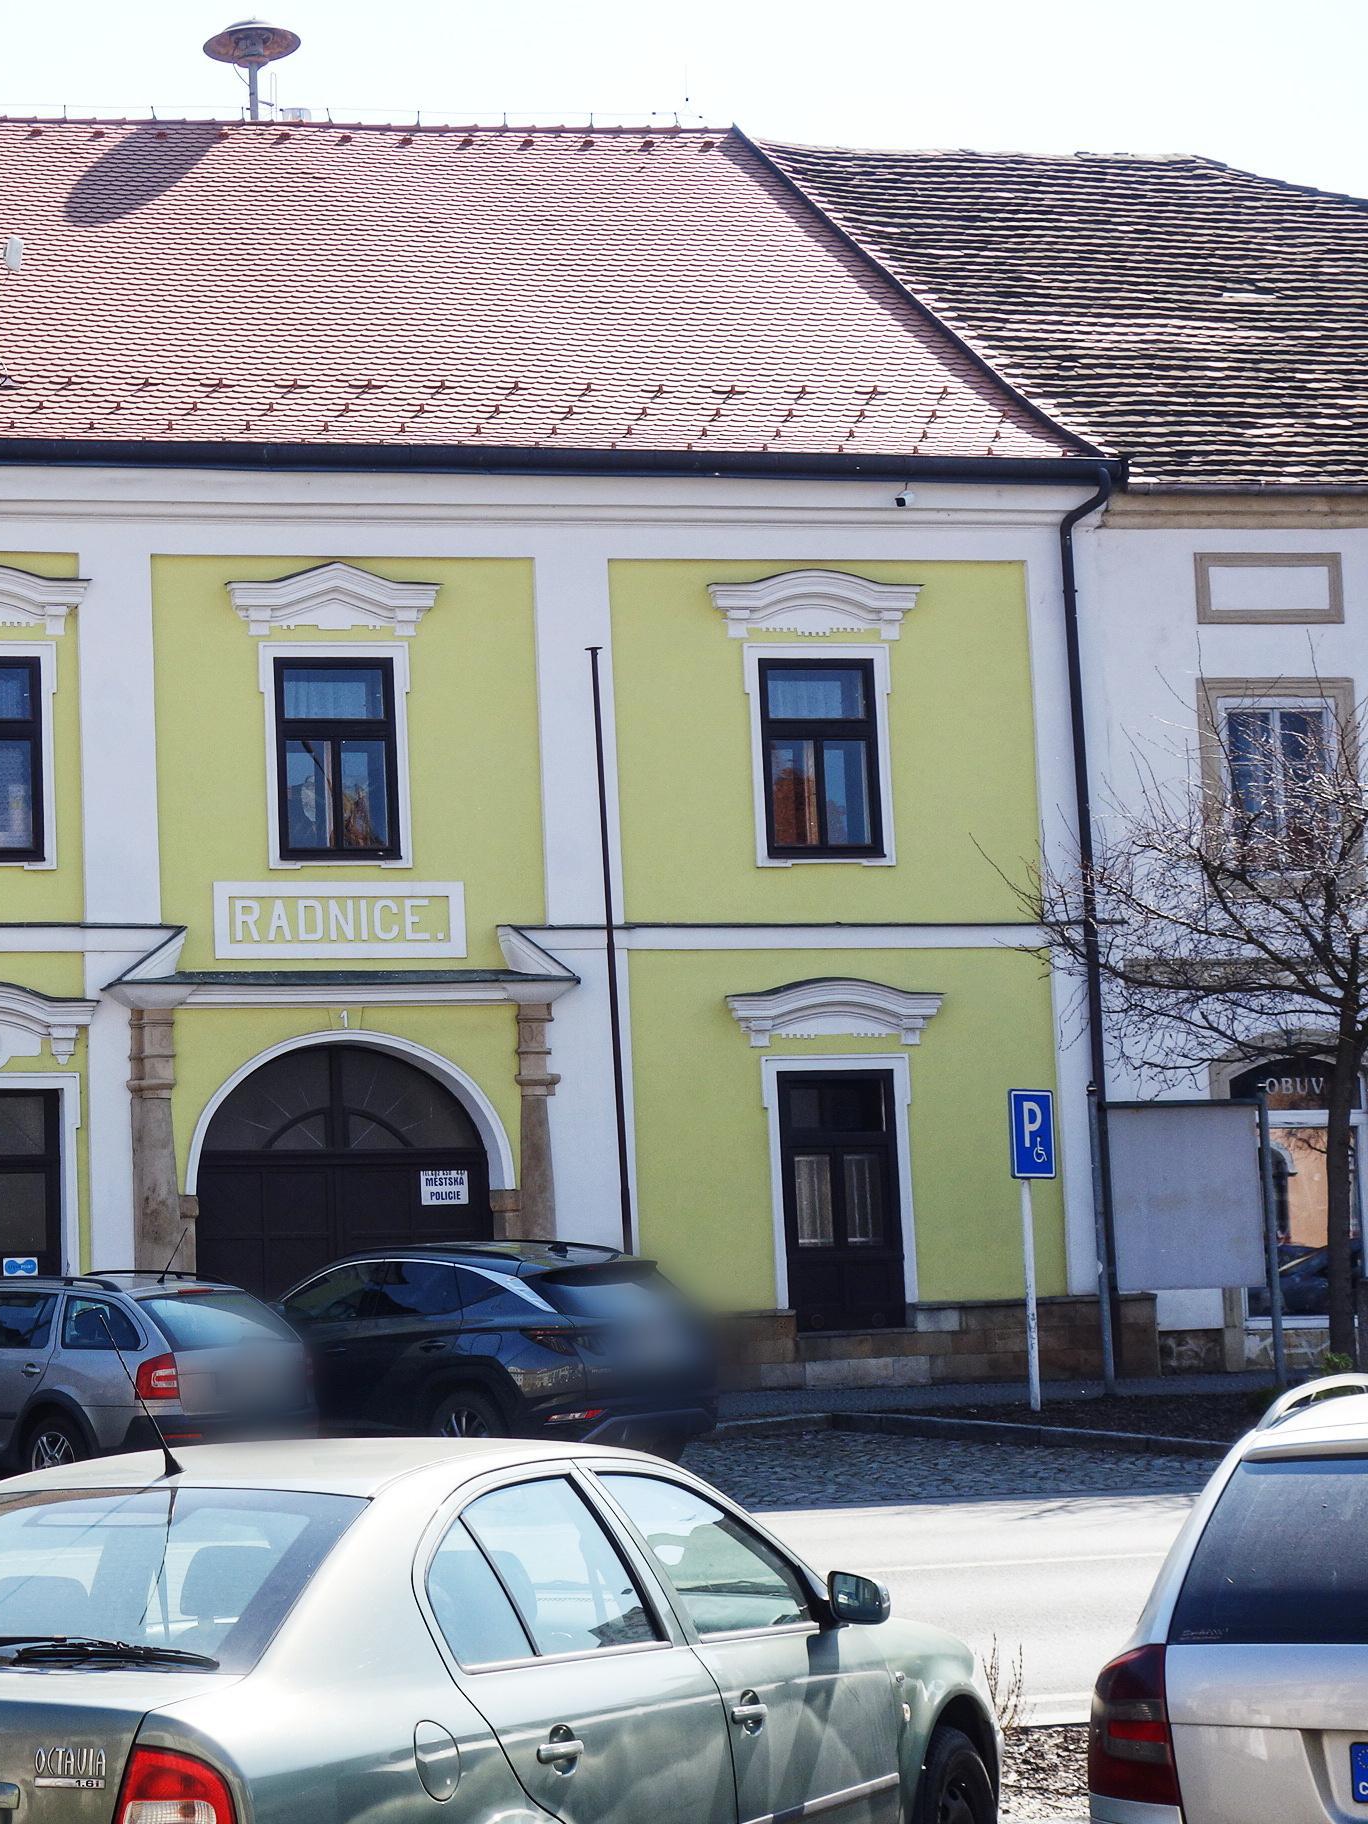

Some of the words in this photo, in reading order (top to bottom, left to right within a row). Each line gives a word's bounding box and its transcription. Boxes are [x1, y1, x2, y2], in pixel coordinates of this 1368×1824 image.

[234, 898, 445, 942] RADNICE.
[340, 1010, 348, 1028] 1
[1265, 1077, 1325, 1095] OBUV
[1023, 1101, 1043, 1148] P
[430, 1190, 462, 1201] POLICIE
[34, 1746, 106, 1777] OCTAVIA
[1358, 1781, 1368, 1795] C
